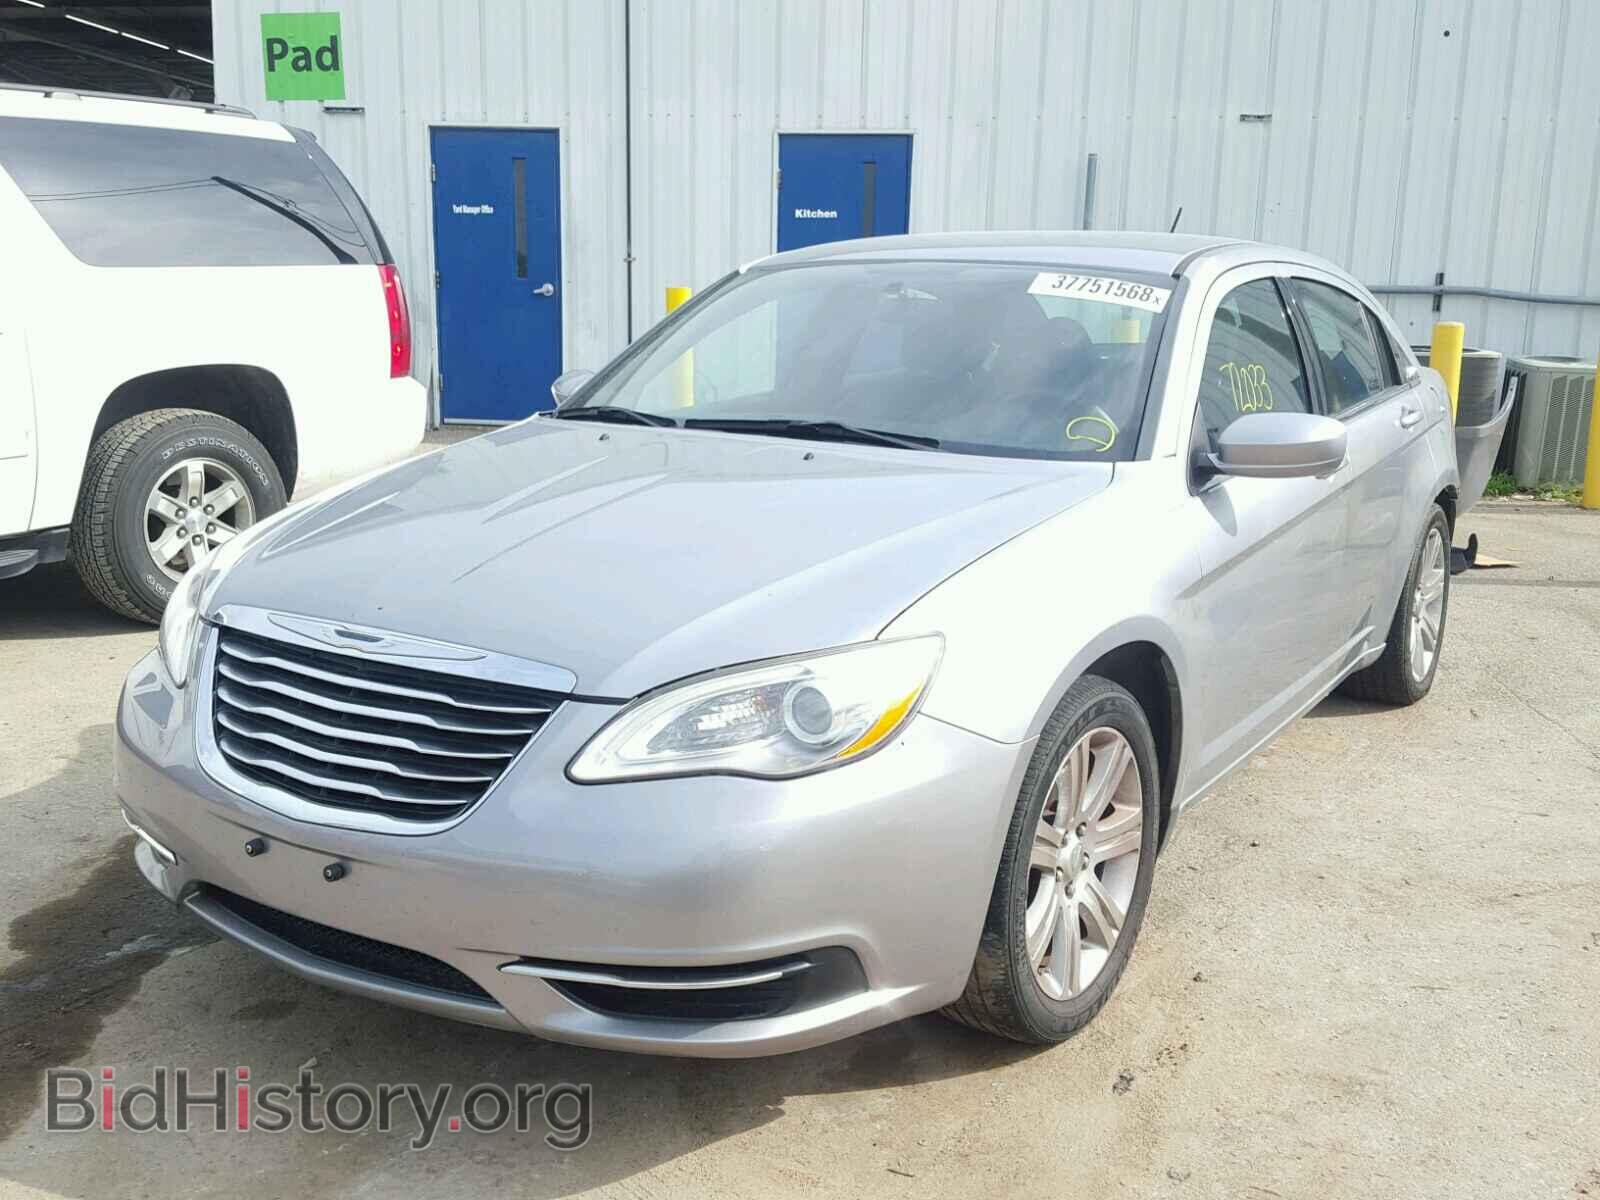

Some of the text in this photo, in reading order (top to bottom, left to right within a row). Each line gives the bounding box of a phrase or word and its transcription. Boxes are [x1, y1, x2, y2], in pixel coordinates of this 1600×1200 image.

[266, 35, 339, 73] Pad
[795, 209, 838, 219] Kitchen
[1052, 275, 1154, 302] 37751568
